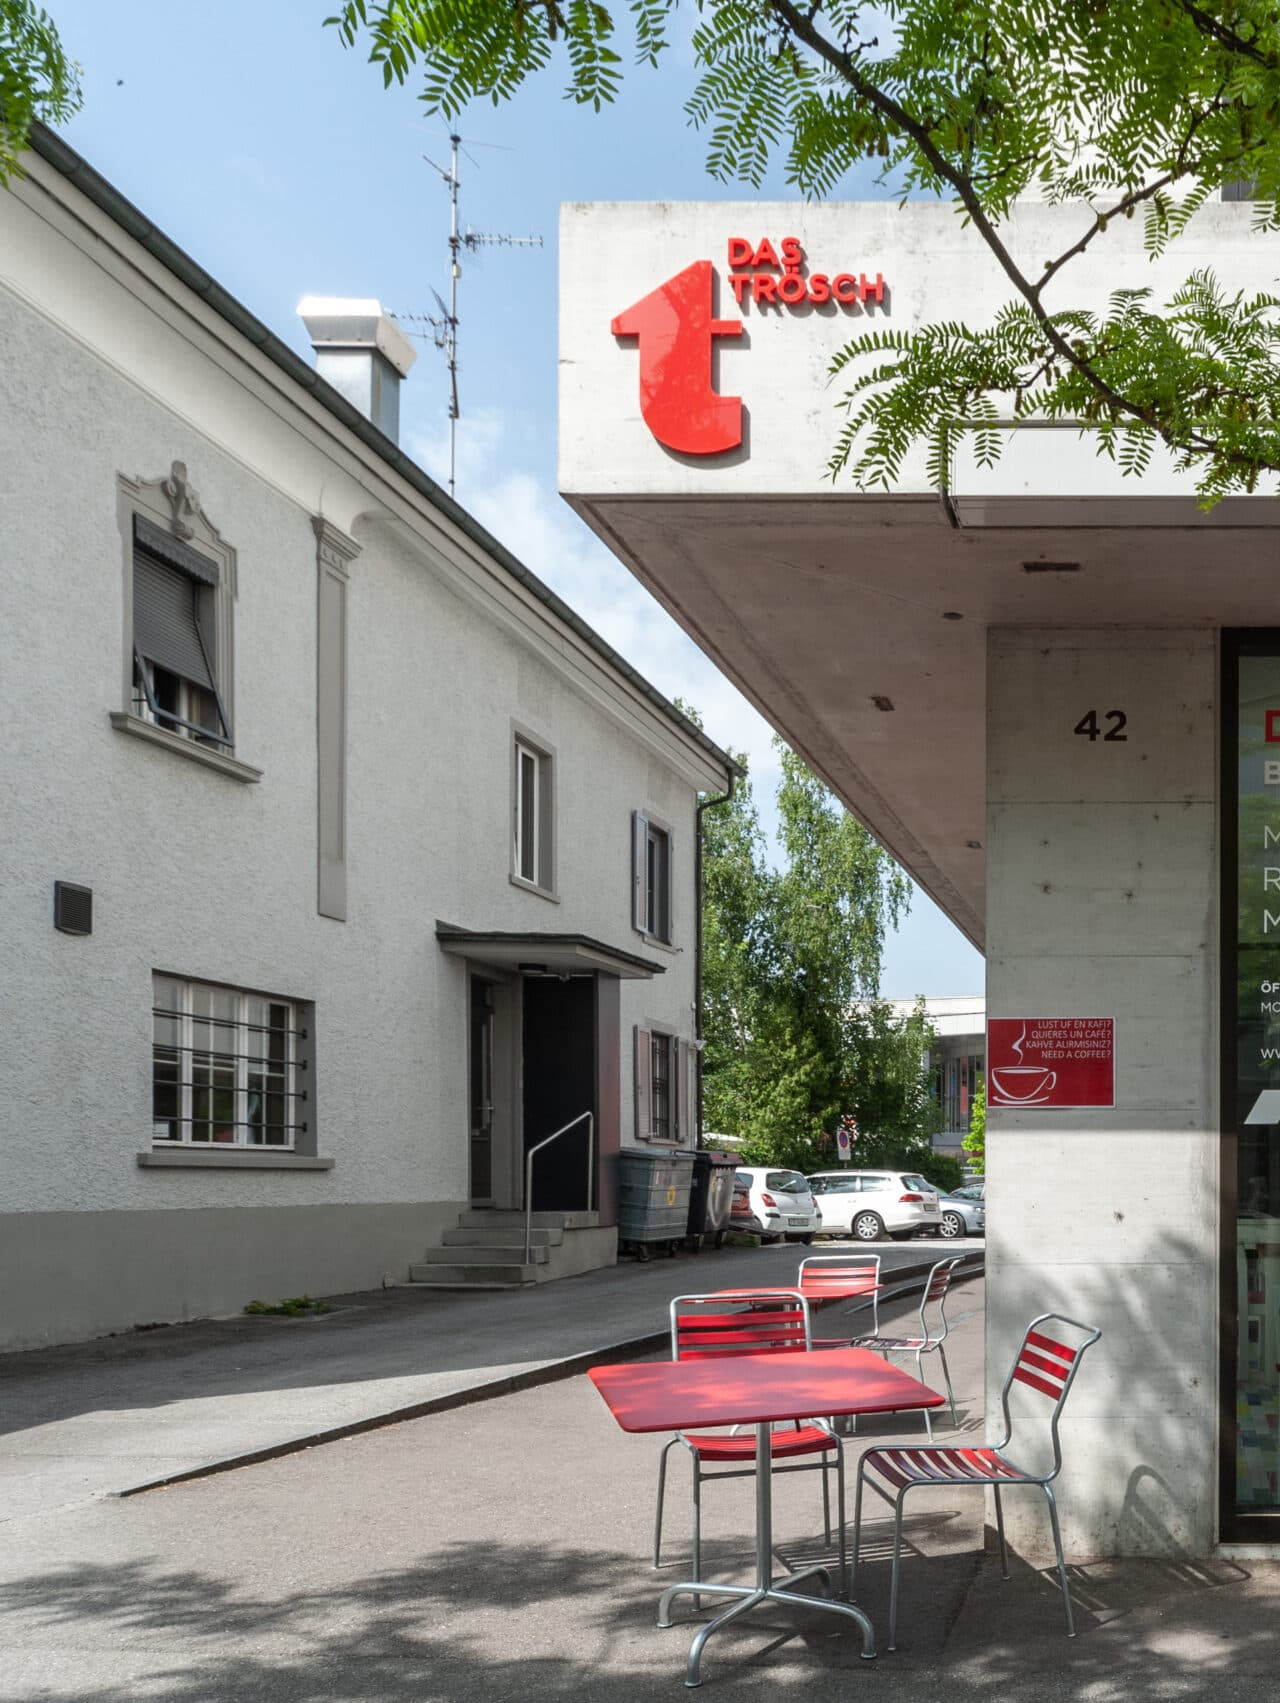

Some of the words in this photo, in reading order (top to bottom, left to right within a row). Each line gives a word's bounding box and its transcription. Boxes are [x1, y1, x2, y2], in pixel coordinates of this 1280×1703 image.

[728, 237, 802, 267] DAS
[728, 266, 885, 305] TRÖSCH
[1073, 709, 1128, 742] 42
[1038, 1020, 1059, 1029] LUST
[1061, 1020, 1072, 1029] UF
[1074, 1020, 1086, 1029] EN
[1031, 1030, 1068, 1039] QUIERES
[1070, 1030, 1083, 1039] UN
[1025, 1040, 1054, 1049] KAHVE
[1041, 1050, 1064, 1059] NEED
[1066, 1050, 1073, 1059] A
[1074, 1050, 1112, 1059] COFFEE?
